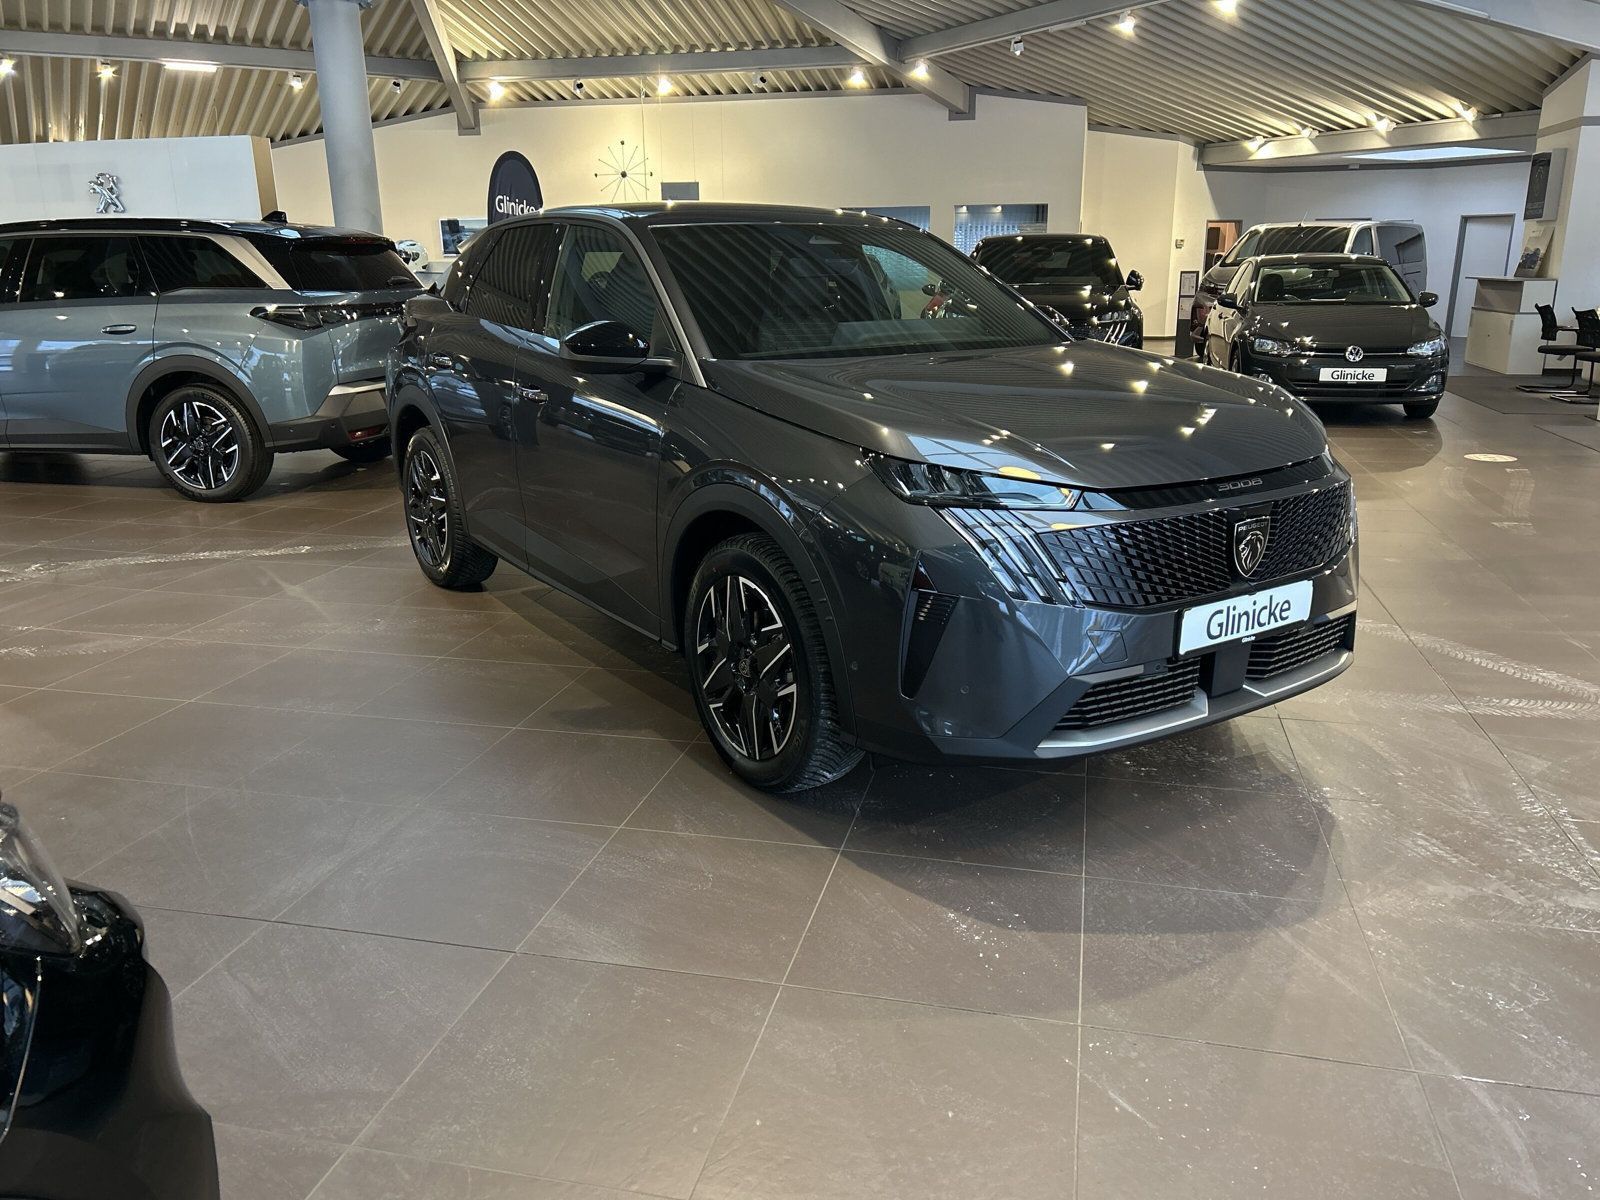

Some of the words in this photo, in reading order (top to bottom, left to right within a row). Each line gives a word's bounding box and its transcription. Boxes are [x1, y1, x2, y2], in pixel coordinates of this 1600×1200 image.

[1331, 370, 1375, 380] Glinicke
[1217, 477, 1263, 491] 3008
[1206, 594, 1291, 640] Glinicke
